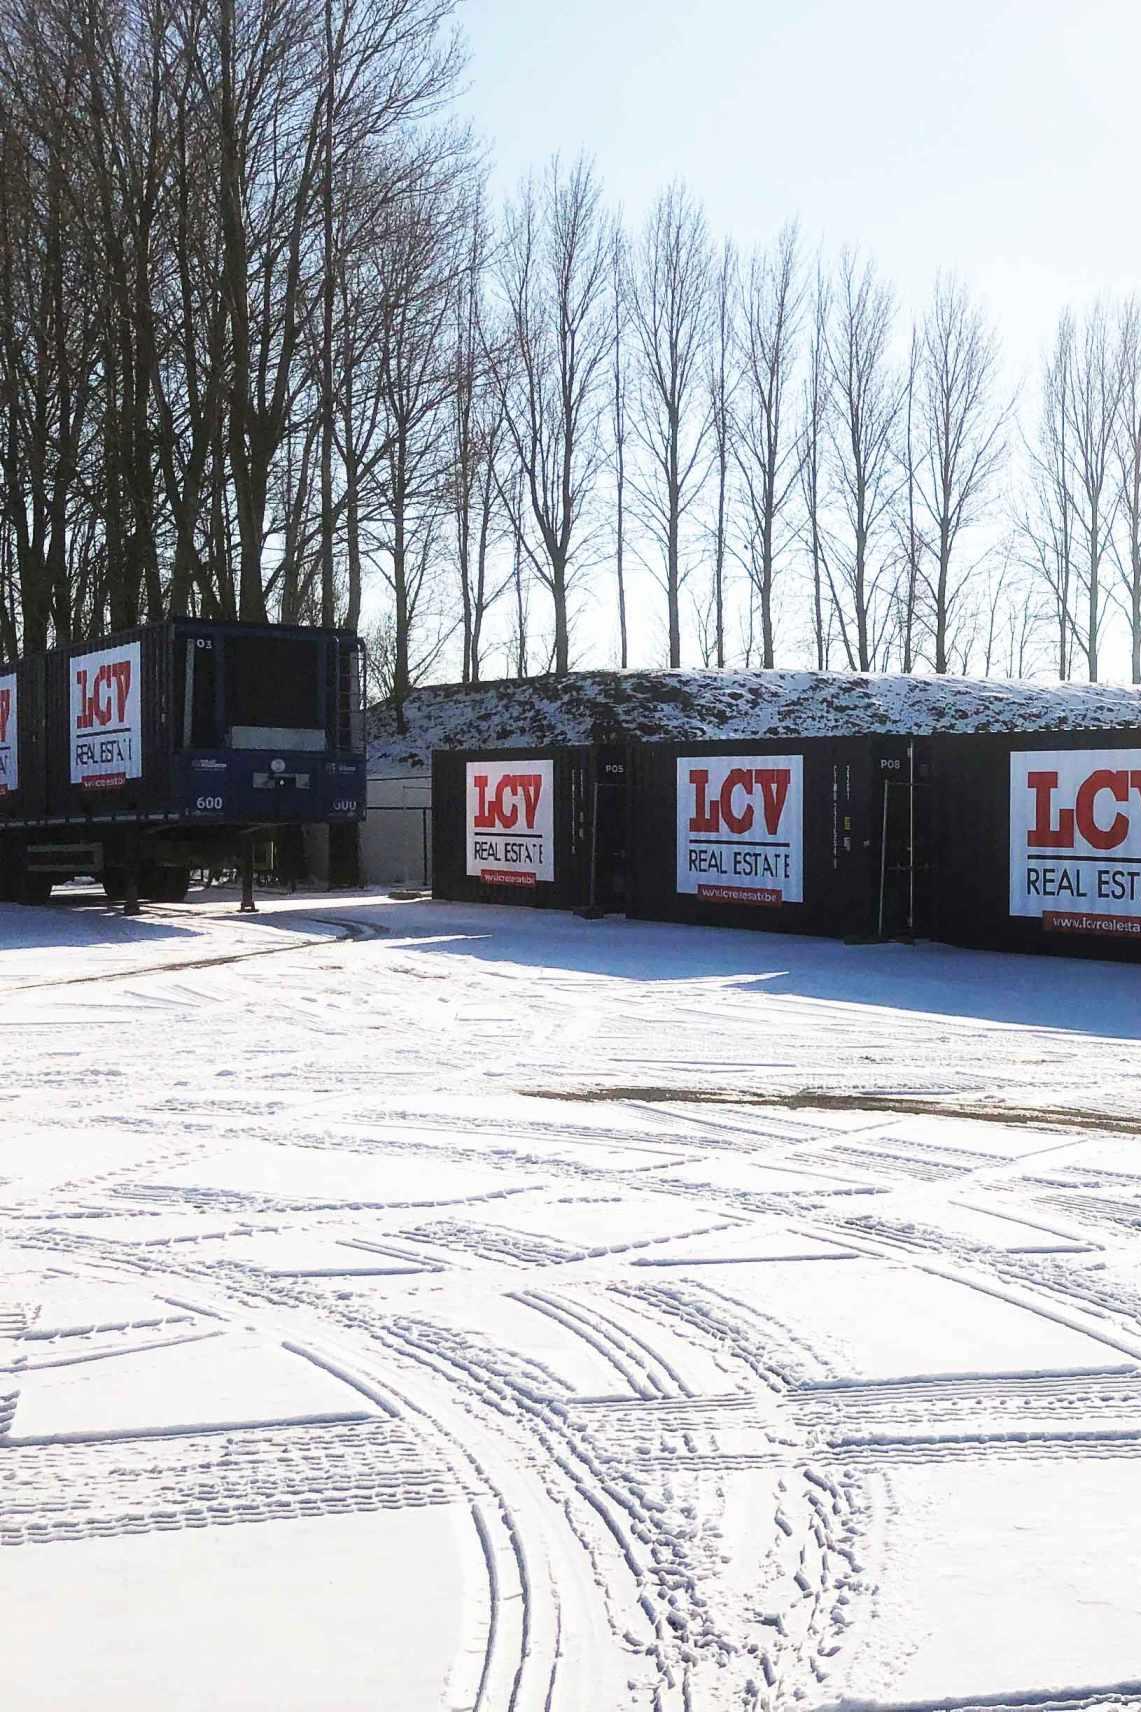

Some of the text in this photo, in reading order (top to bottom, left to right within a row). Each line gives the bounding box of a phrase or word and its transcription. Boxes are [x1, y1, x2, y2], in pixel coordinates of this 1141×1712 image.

[76, 660, 131, 729] LCV
[196, 797, 223, 809] 600
[474, 775, 542, 829] LCV
[689, 768, 791, 835] LCV
[474, 841, 543, 865] REAL ESTATE
[688, 848, 790, 879] REAL ESTATE
[1026, 868, 1087, 897] REAL
